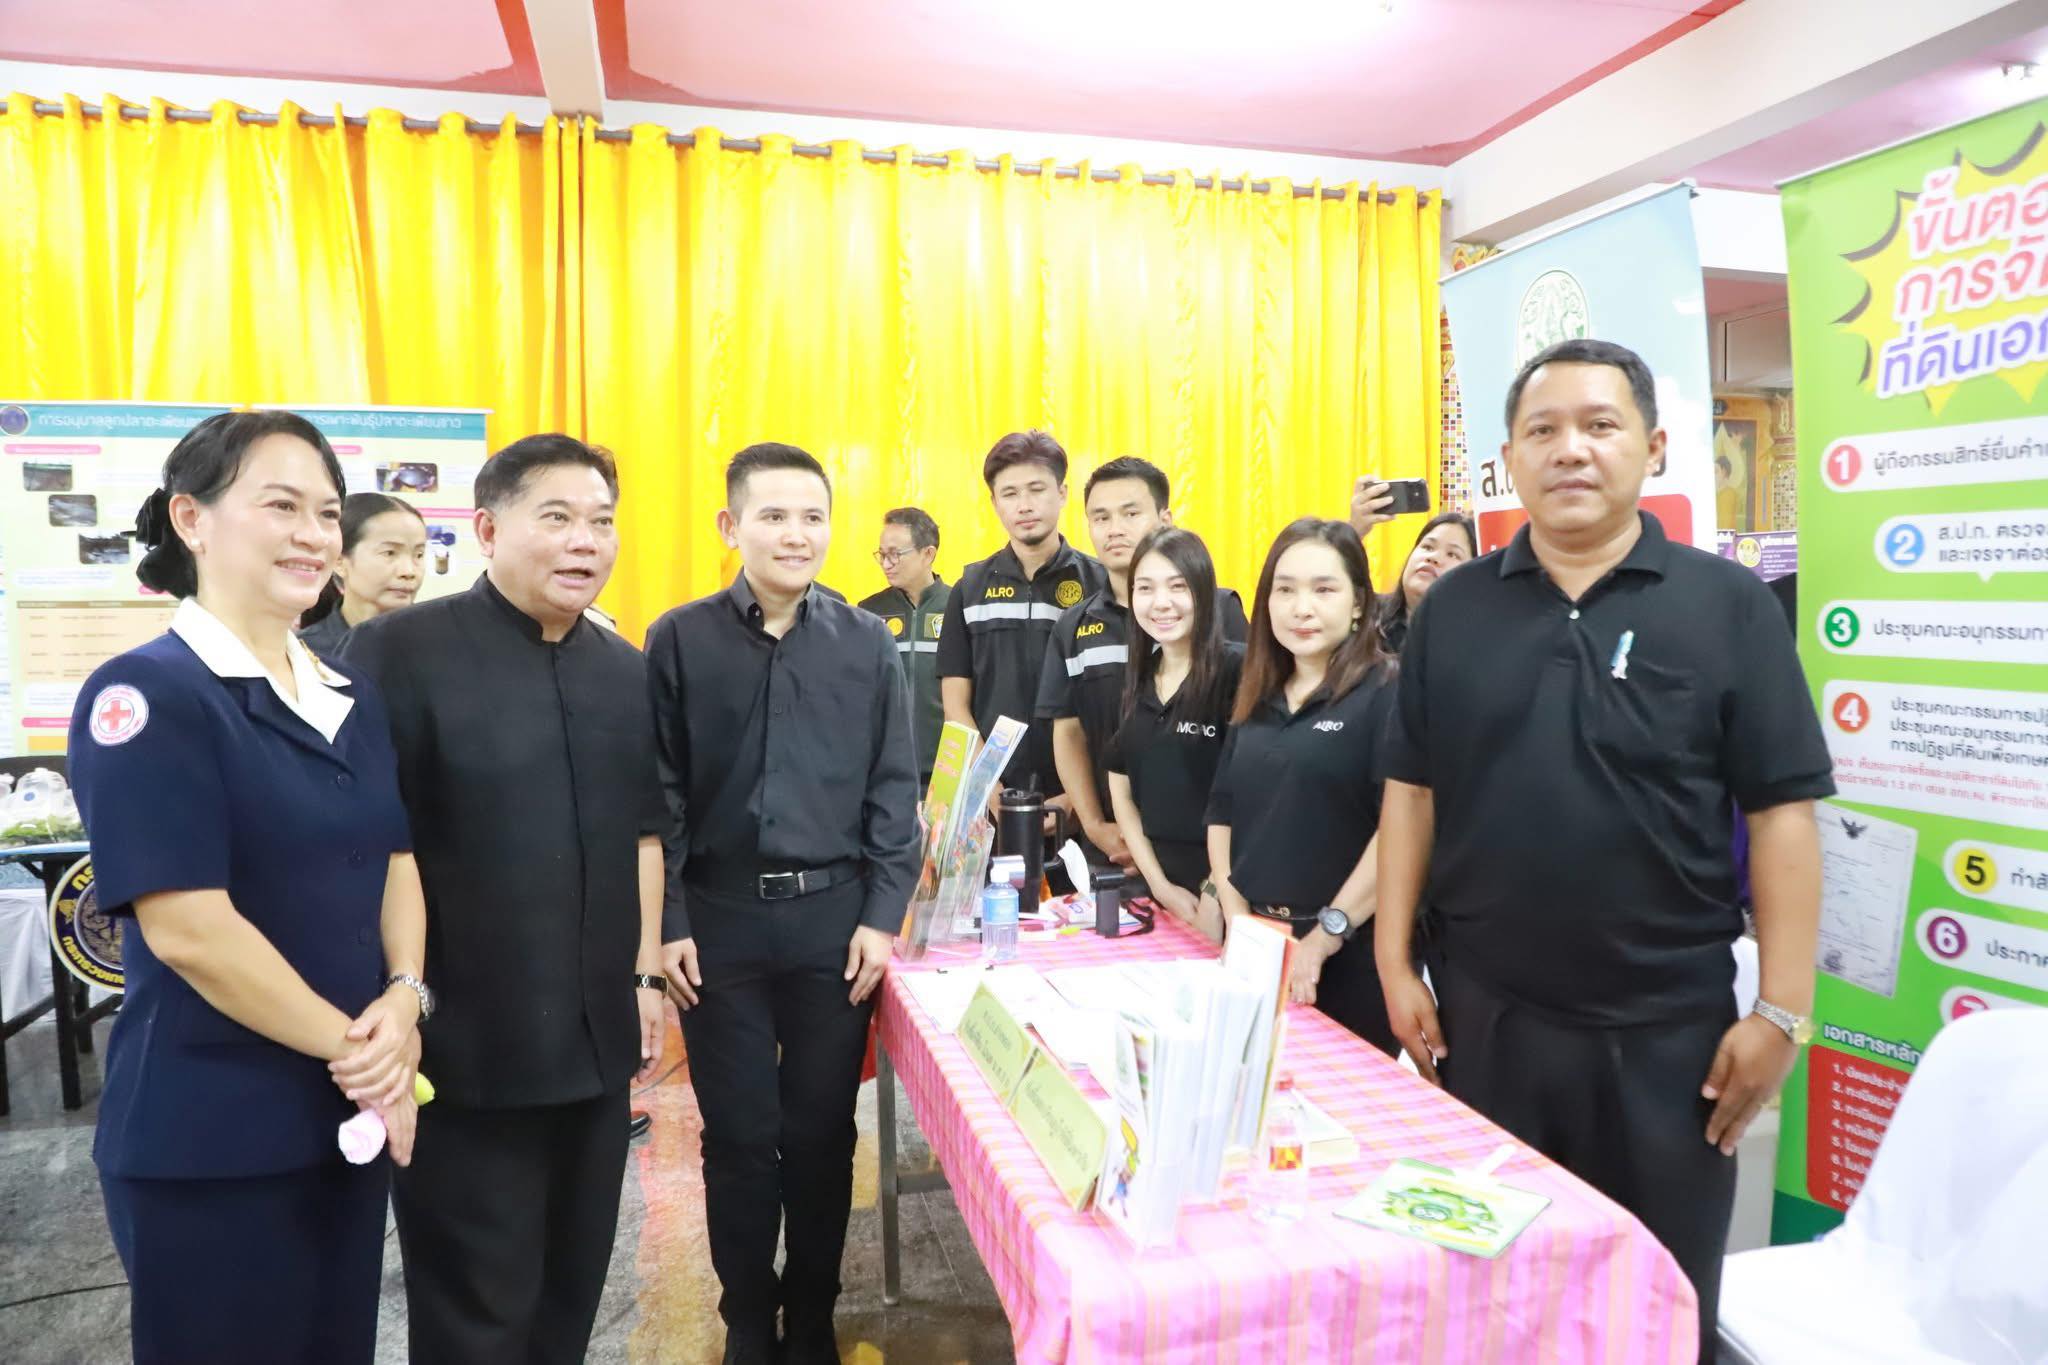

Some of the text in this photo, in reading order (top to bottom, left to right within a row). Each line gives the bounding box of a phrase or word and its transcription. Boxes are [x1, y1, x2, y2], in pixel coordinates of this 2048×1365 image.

[1835, 451, 1849, 480] 1
[1893, 528, 1918, 561] 2
[1996, 523, 2048, 539] ตรวจ
[985, 586, 1015, 599] ALRO
[1076, 622, 1104, 639] ALRO
[1832, 612, 2048, 645] 3 ประชุมคณะอนุกรรมก
[1839, 698, 1862, 728] 4
[1964, 855, 1986, 886] 5
[1933, 922, 1960, 954] 6
